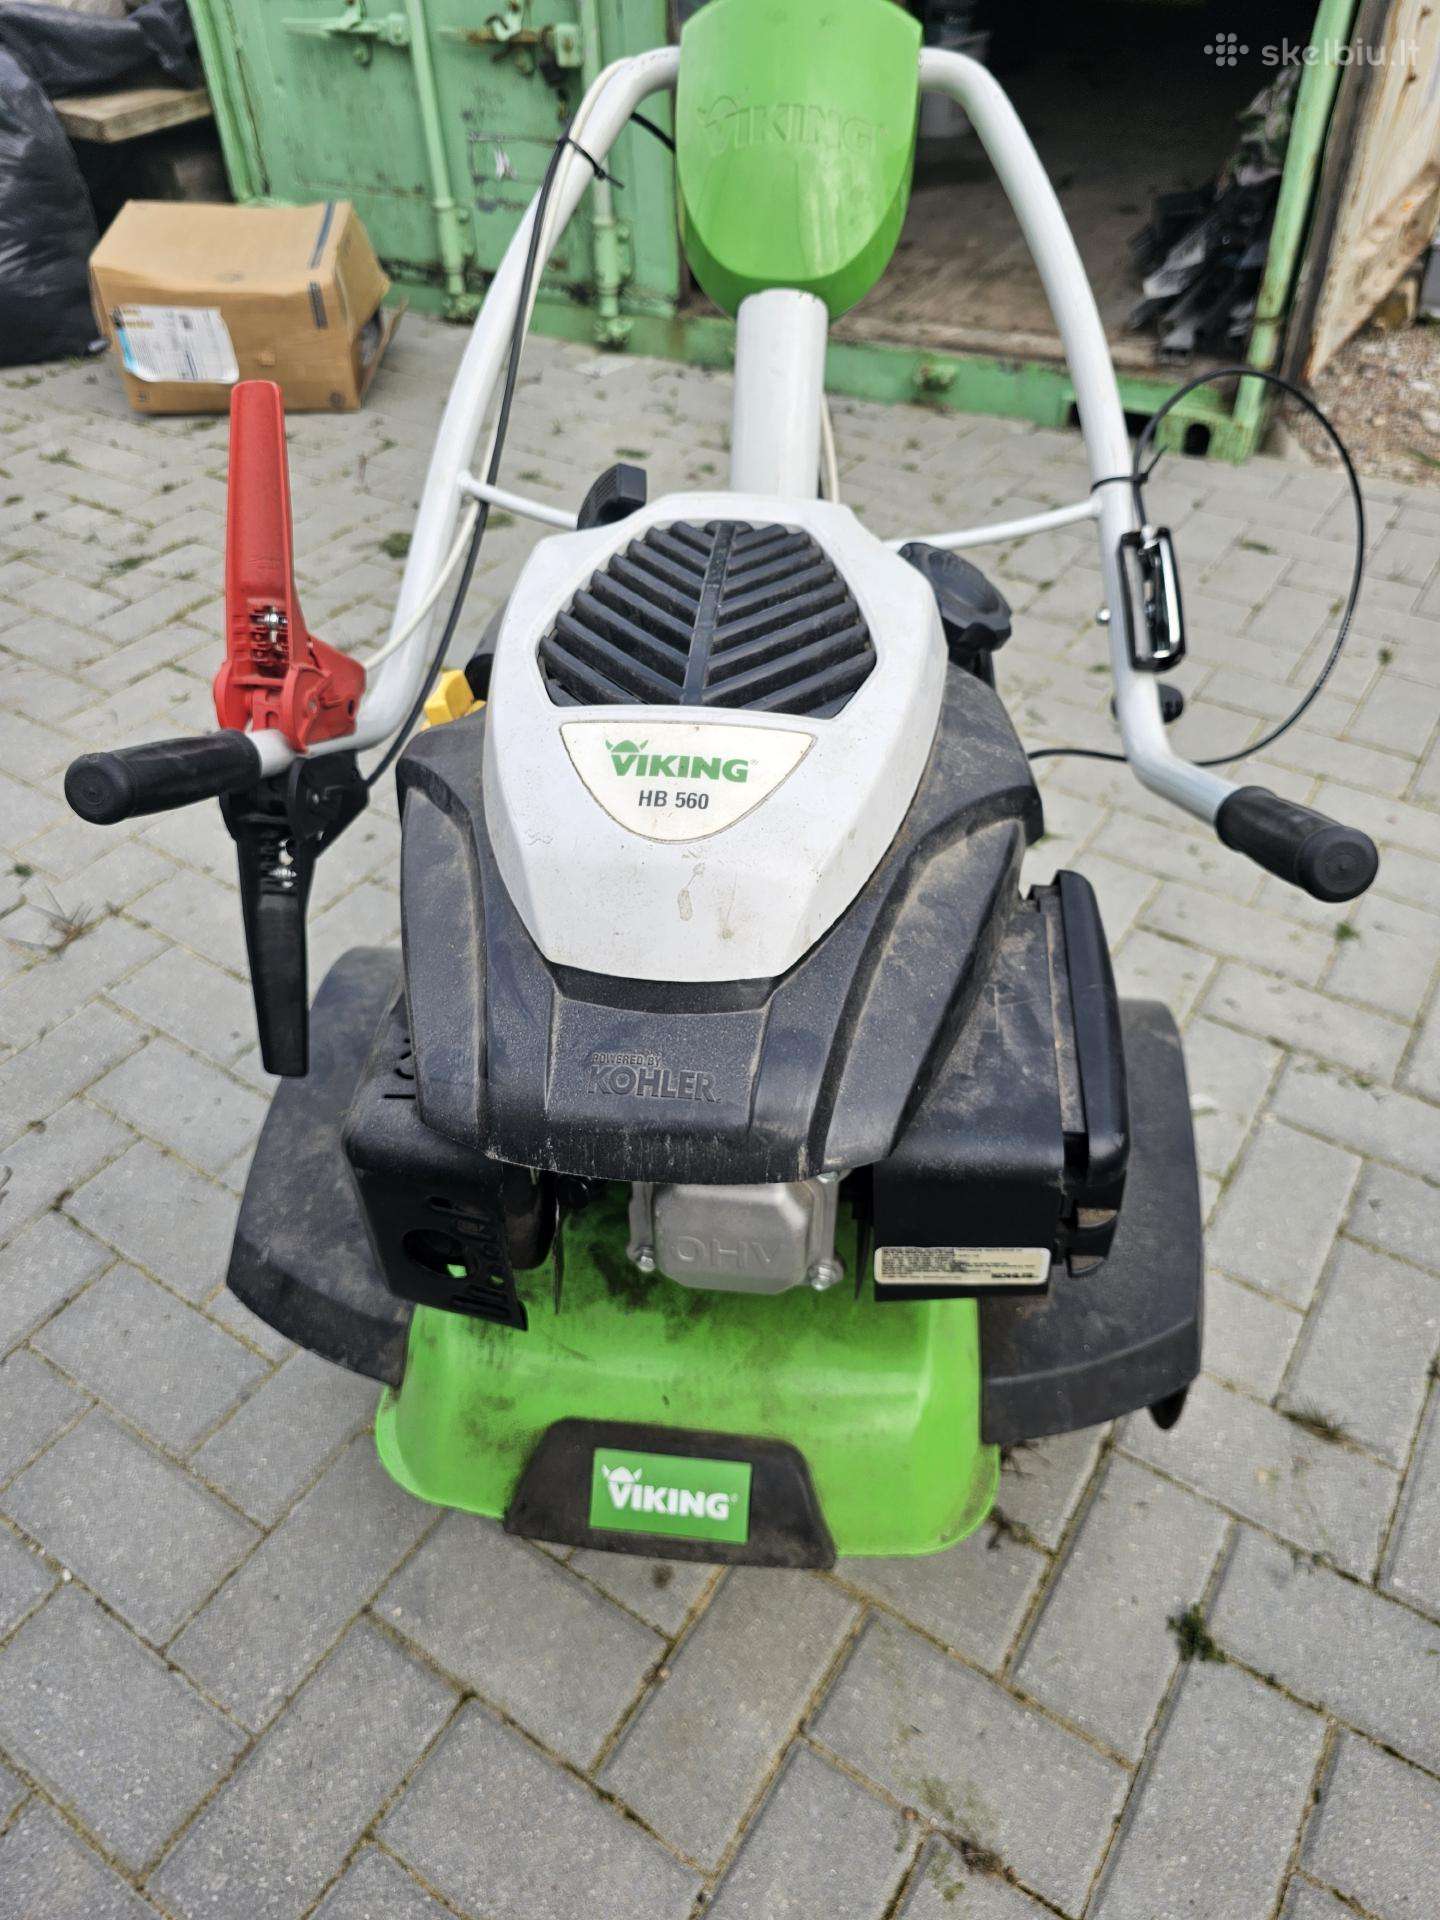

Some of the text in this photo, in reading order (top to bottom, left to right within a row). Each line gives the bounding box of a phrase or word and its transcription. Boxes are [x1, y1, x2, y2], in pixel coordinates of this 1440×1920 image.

[611, 754, 749, 783] VIKING
[638, 789, 710, 809] HB 560
[592, 1052, 661, 1068] POWERED BY
[587, 1064, 717, 1102] KOHLER
[670, 1235, 779, 1271] OHV
[608, 1481, 730, 1521] VIKING
